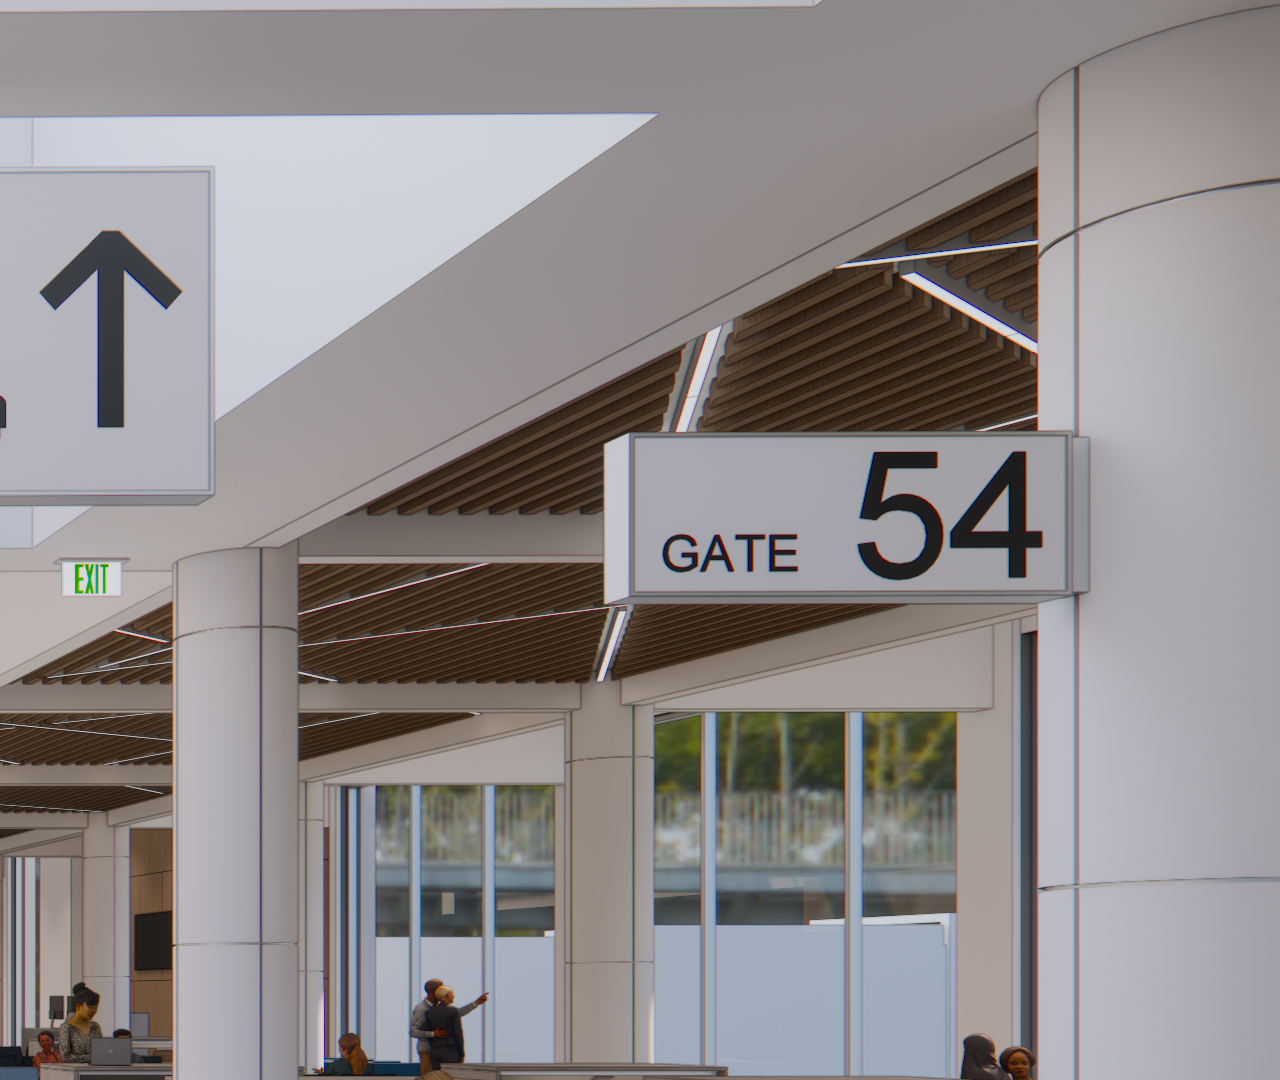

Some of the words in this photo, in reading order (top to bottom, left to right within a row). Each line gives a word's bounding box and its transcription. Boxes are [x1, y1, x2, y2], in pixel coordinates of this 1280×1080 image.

[662, 534, 798, 573] GATE
[857, 451, 1044, 581] 54
[74, 564, 109, 595] EXIT
